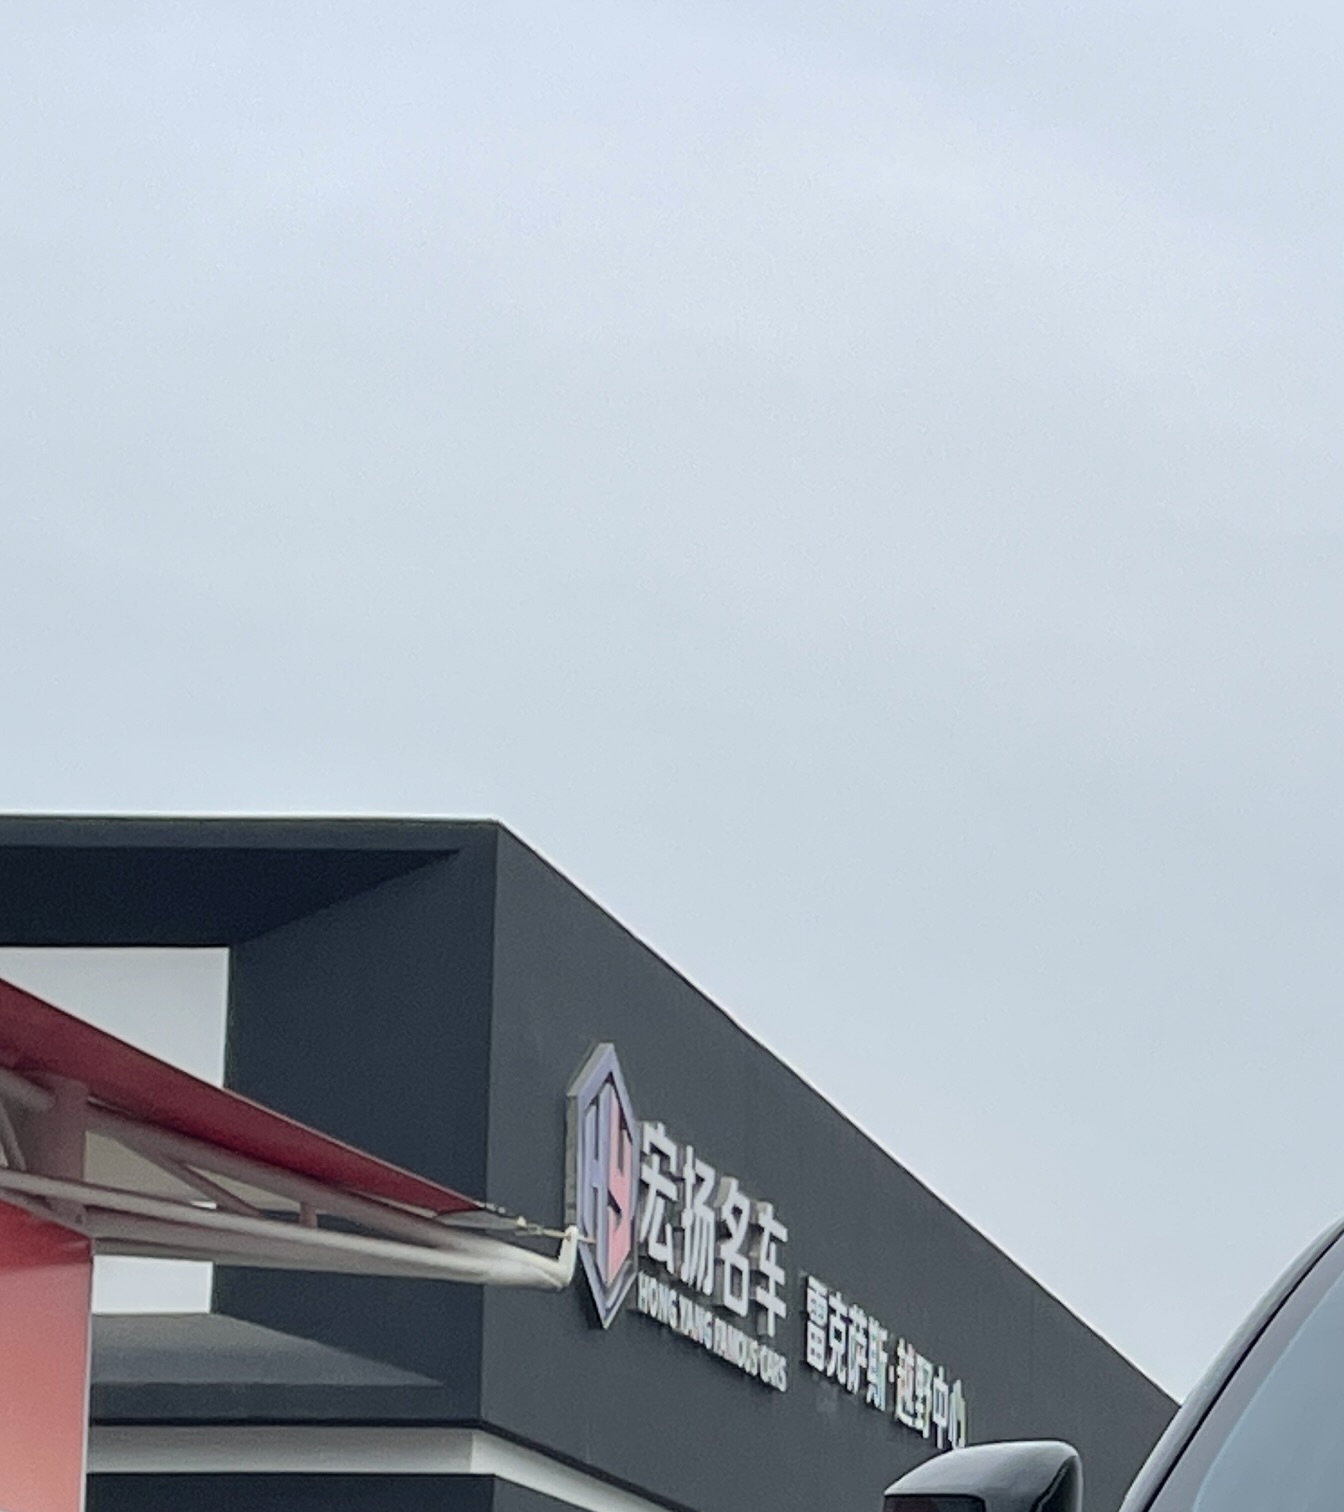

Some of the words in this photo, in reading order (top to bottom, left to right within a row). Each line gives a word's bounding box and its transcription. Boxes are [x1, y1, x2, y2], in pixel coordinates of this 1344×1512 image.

[641, 1122, 788, 1337] 宏扬名车
[637, 1270, 678, 1330] HONG
[678, 1294, 713, 1351] YANG
